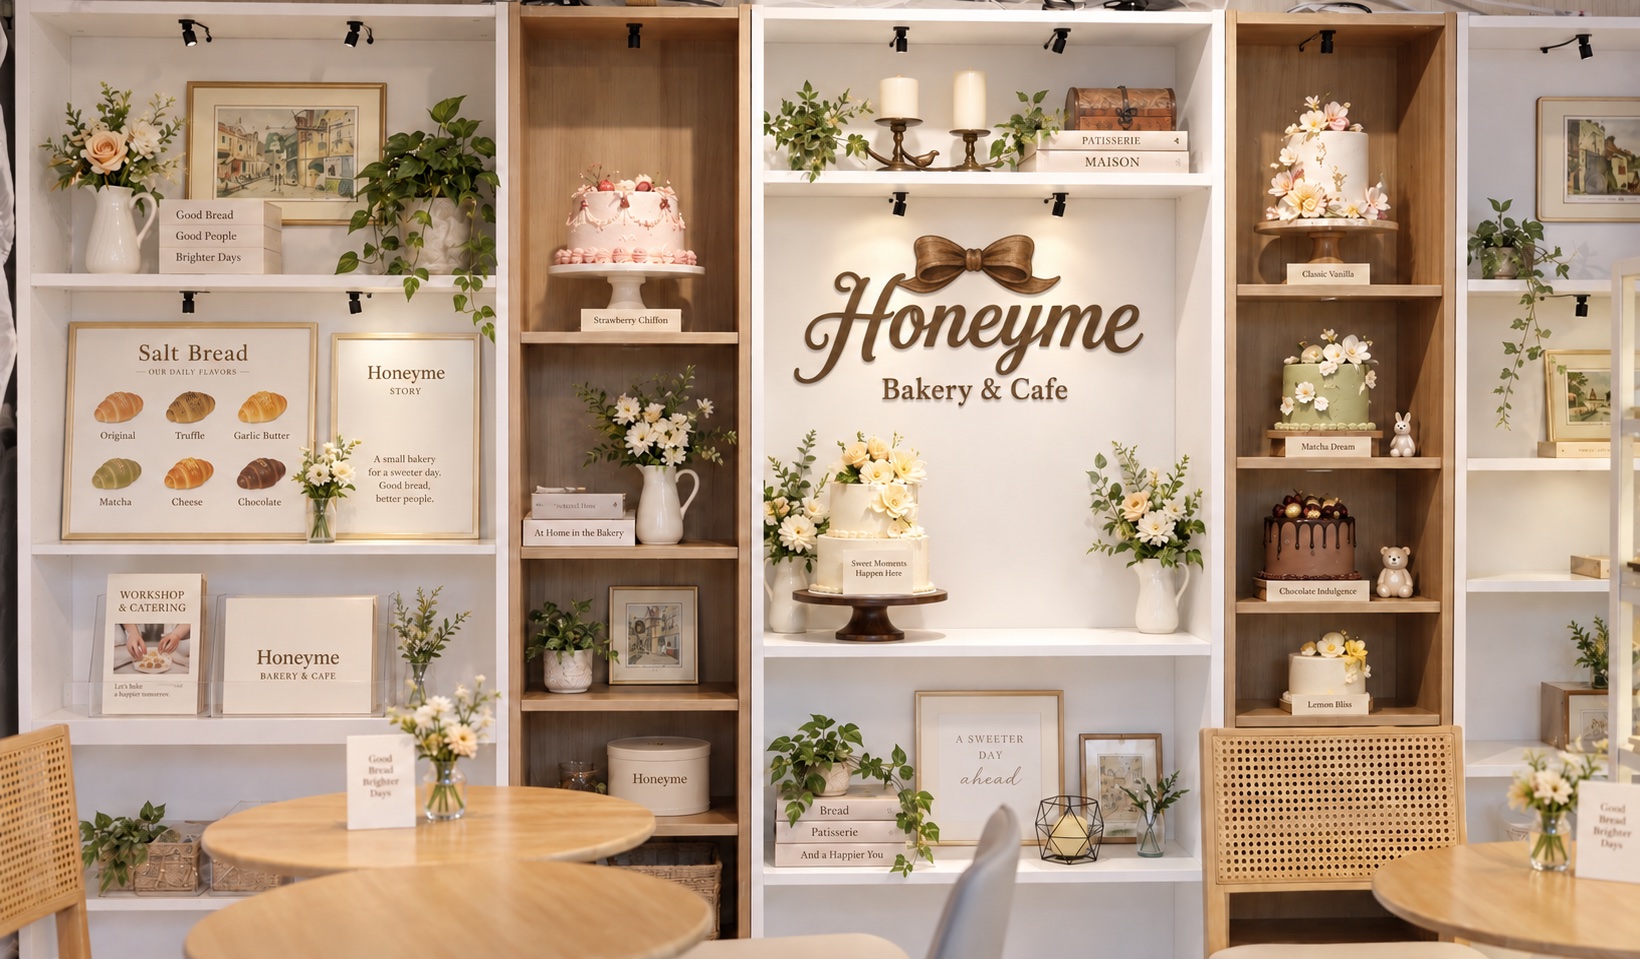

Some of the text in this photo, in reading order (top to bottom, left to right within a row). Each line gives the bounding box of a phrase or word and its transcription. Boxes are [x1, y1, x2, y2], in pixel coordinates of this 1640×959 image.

[1082, 136, 1141, 145] PATISSERIE
[1085, 157, 1139, 167] MAISON
[176, 210, 233, 220] Good Bread
[175, 231, 237, 243] Good People
[176, 252, 241, 264] Brighter Days
[1302, 270, 1354, 278] Classic Vanilla
[594, 316, 668, 326] Strawberry Chiffon
[794, 271, 1144, 384] Honeyme
[139, 344, 248, 361] Salt Bread
[368, 365, 445, 384] Honeyme
[390, 387, 421, 395] STORY
[882, 377, 1068, 407] Bakery & Cafe
[100, 431, 136, 442] Original
[175, 431, 205, 440] Truffle
[234, 431, 290, 440] Garlic Butter
[1301, 442, 1355, 451] Matcha Dream
[373, 454, 436, 465] A small bakery
[368, 468, 381, 476] for
[424, 468, 441, 479] day.
[379, 481, 431, 490] Good bread,
[100, 497, 132, 506] Matcha
[171, 497, 203, 506] Cheese
[238, 497, 282, 506] Chocolate
[376, 494, 434, 505] better people.
[534, 528, 624, 539] At Home in the Bakery
[855, 569, 902, 579] Happen Here
[120, 590, 185, 599] WORKSHOP
[1279, 587, 1357, 597] Chocolate Indulgence
[118, 603, 186, 612] & CATERING
[257, 649, 339, 670] Honeyme
[260, 672, 336, 680] BAKERY & CAFE
[1335, 700, 1352, 708] Bliss
[956, 735, 1024, 744] A SWEETER
[368, 754, 393, 763] Good
[979, 750, 1003, 760] DAY
[368, 766, 394, 774] Bread
[633, 773, 688, 787] Honeyme
[960, 766, 1022, 786] ahead
[363, 777, 399, 788] Brighter
[370, 789, 391, 799] Days
[820, 805, 849, 815] Bread
[812, 827, 858, 837] Patisserie
[800, 850, 820, 859] And
[829, 850, 865, 861] Happier
[867, 850, 884, 859] You
